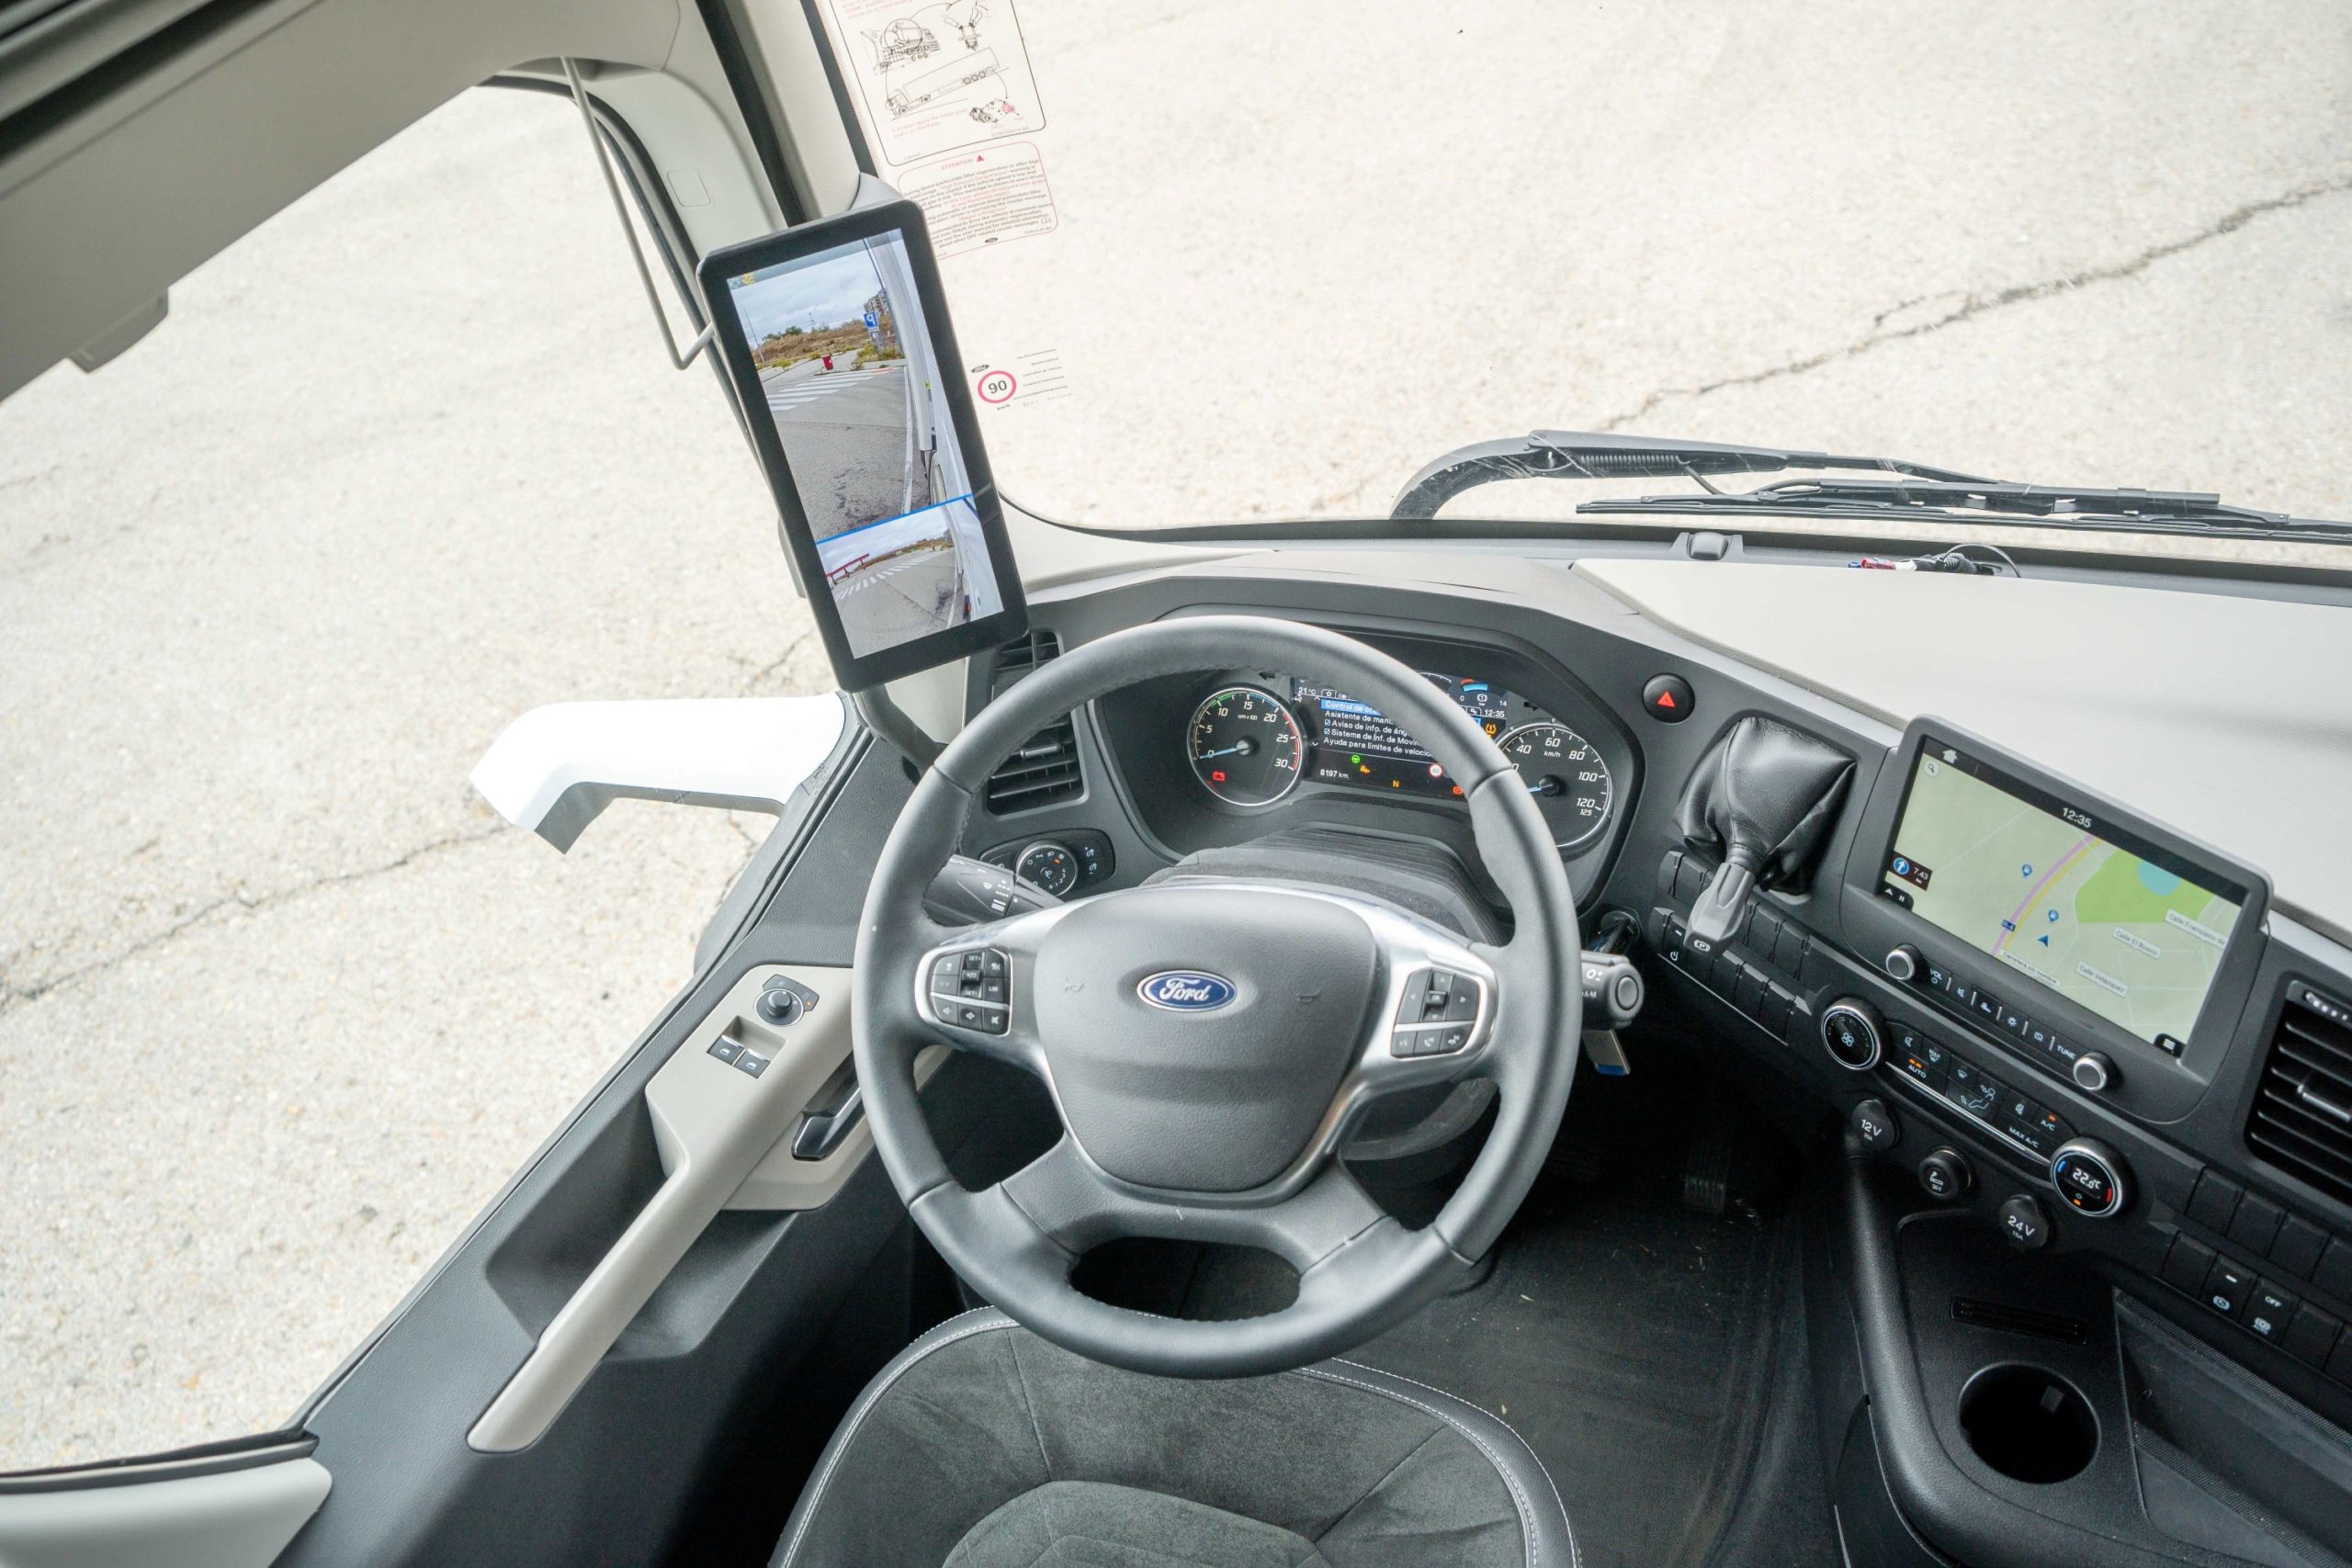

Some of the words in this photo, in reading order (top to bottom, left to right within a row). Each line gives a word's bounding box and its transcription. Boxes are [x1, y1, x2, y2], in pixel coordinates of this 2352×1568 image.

[940, 158, 974, 170] ATTENTION
[989, 380, 1007, 394] 90
[1243, 701, 1253, 710] 15
[1325, 702, 1352, 710] Control
[1218, 707, 1228, 716] 10
[1325, 711, 1360, 720] Asistente
[1484, 709, 1505, 718] 12:35
[1263, 713, 1277, 723] 20
[1331, 720, 1352, 729] Aviso
[1275, 733, 1288, 743] 25
[1331, 729, 1362, 739] Sistema
[1363, 732, 1373, 740] de
[1323, 737, 1347, 746] Ayuda
[1349, 740, 1366, 750] para
[1545, 738, 1560, 748] 60
[1516, 745, 1532, 754] 40
[1544, 750, 1561, 759] km/h
[1568, 751, 1586, 761] 80
[1274, 759, 1288, 768] 30
[1319, 768, 1338, 777] 8197
[1578, 772, 1599, 783] 100
[1393, 780, 1400, 788] N
[1577, 797, 1595, 808] 120
[2063, 807, 2092, 829] 12:35
[1913, 867, 1929, 880] 7.43
[2116, 930, 2132, 942] Calle
[1929, 968, 1943, 981] VOL
[2079, 964, 2094, 976] Calle
[1159, 977, 1213, 1001] Ford
[2058, 1044, 2076, 1060] TUNE
[1907, 1065, 1927, 1078] AUTO
[2040, 1120, 2056, 1132] A/C
[2008, 1126, 2025, 1139] MAX
[2025, 1137, 2039, 1148] A/C
[2265, 1295, 2282, 1307] OFF
